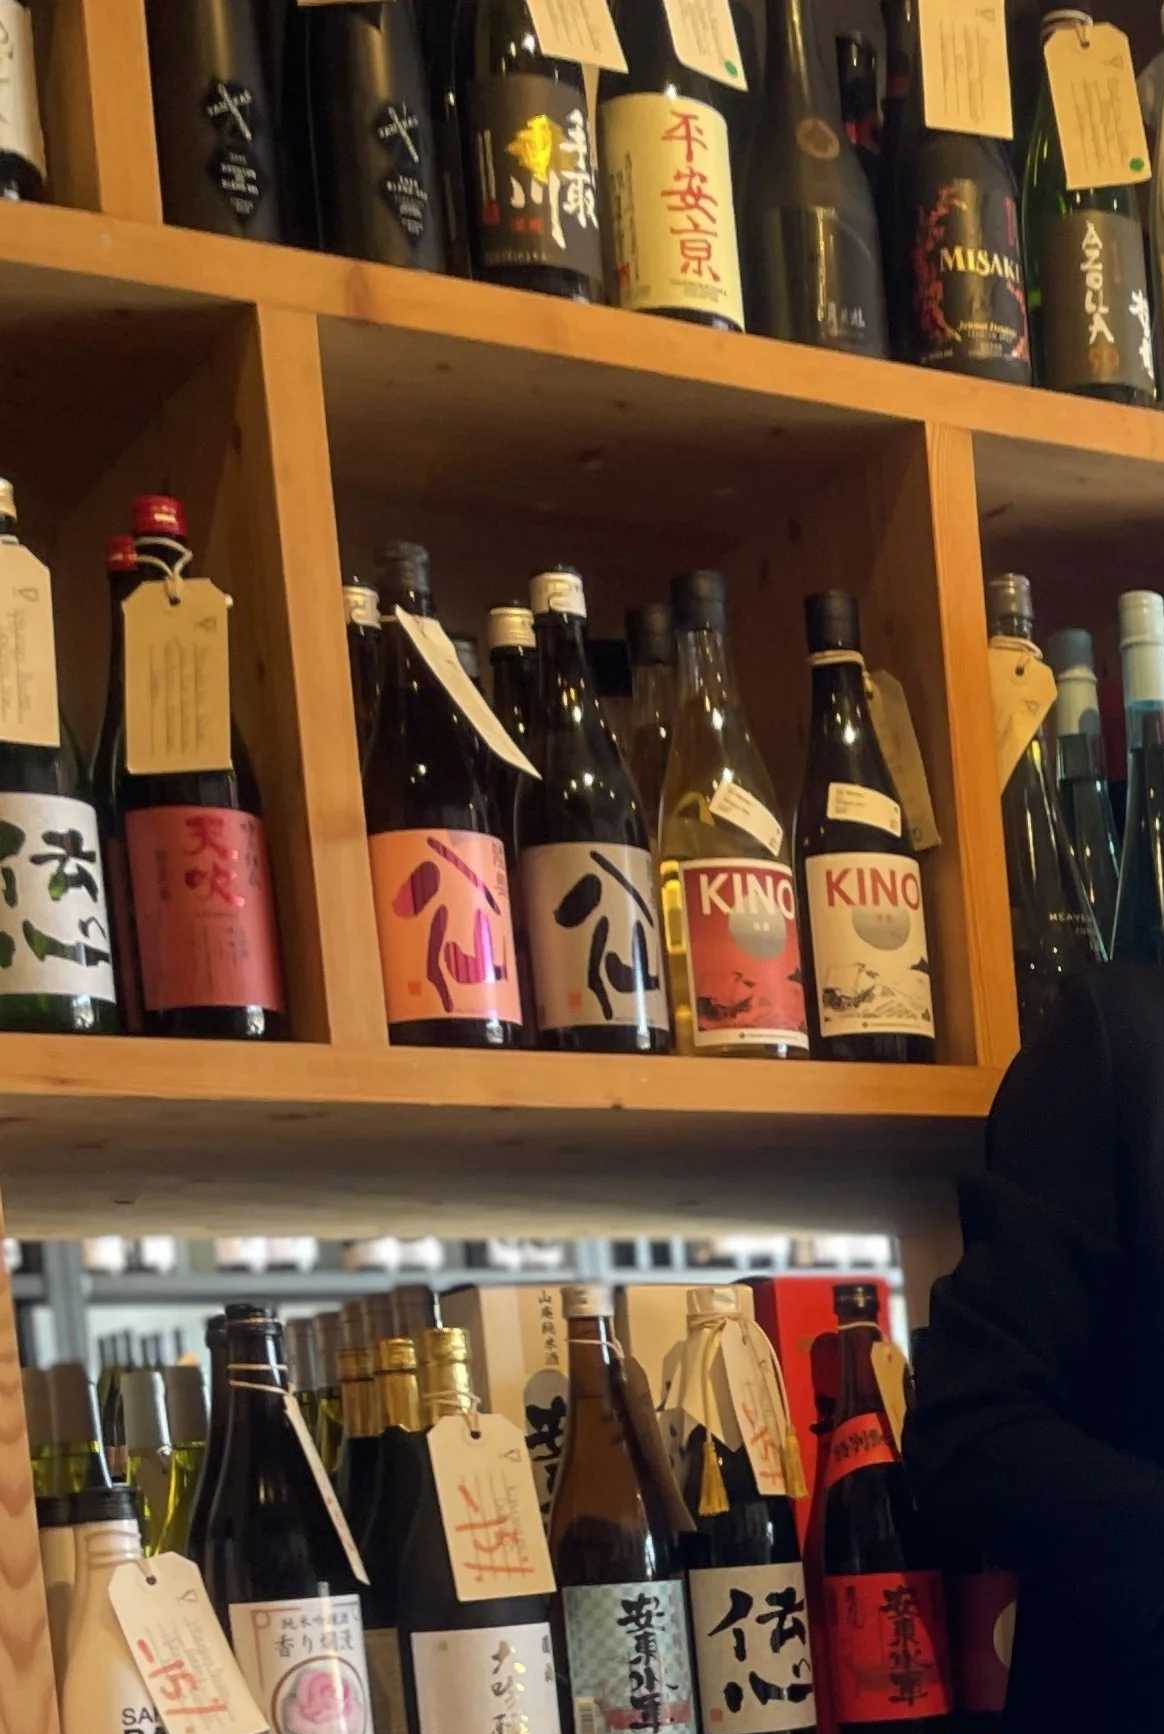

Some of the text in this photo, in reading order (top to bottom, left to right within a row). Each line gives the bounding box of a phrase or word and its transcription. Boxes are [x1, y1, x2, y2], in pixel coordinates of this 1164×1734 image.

[660, 109, 720, 283] 平安京
[940, 246, 1021, 284] MISAKI
[701, 872, 795, 920] KINO
[825, 868, 920, 910] KINO
[707, 1586, 812, 1714] 伝心
